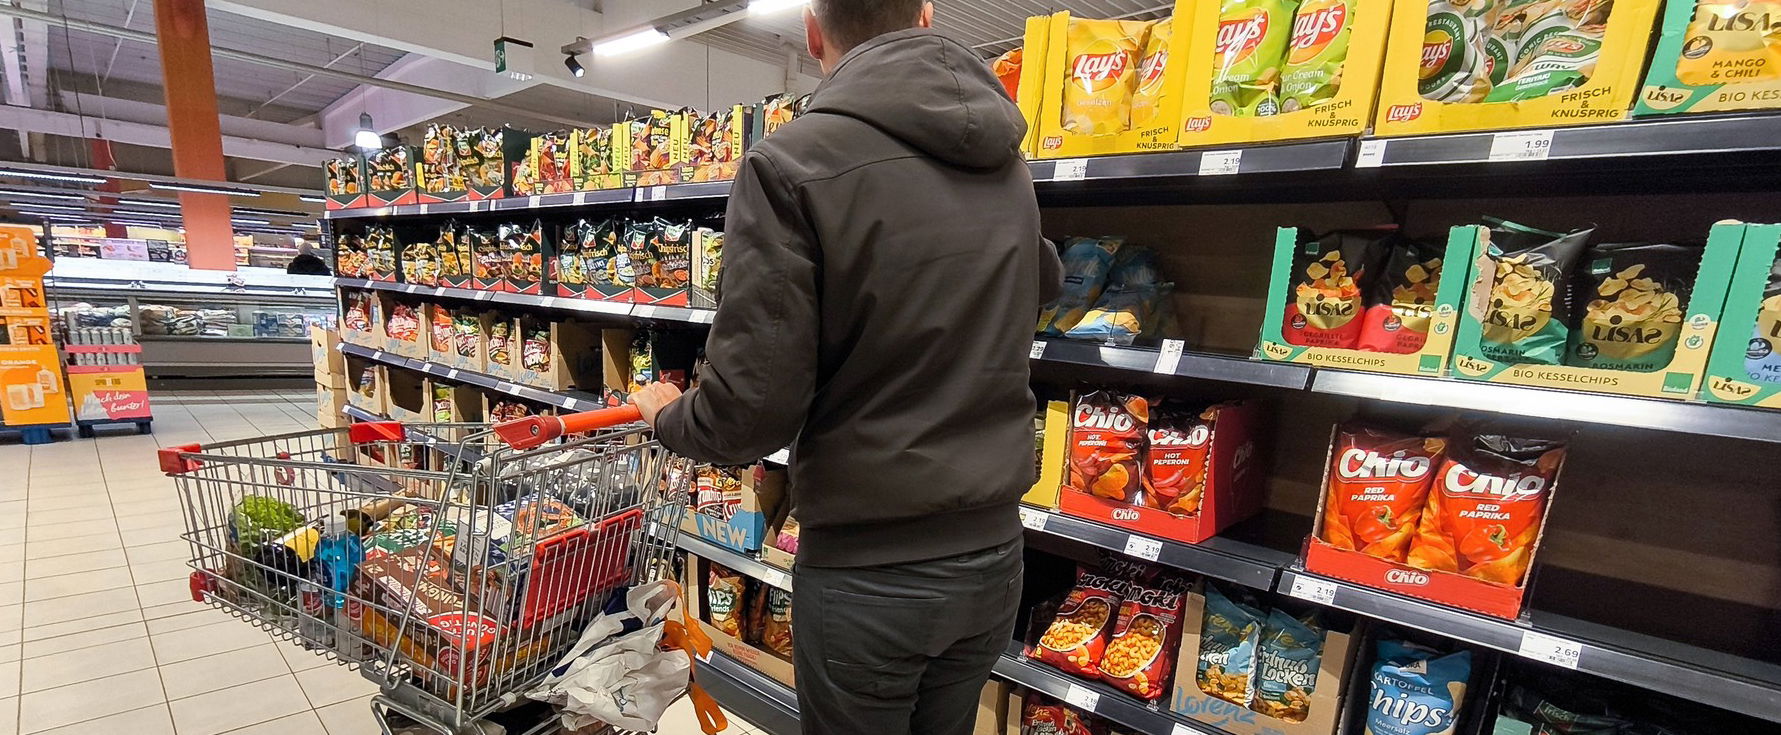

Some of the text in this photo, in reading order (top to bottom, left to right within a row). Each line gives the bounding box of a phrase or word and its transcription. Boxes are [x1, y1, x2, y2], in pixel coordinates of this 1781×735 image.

[1216, 14, 1266, 52] ay's
[1290, 7, 1342, 48] ay's
[1073, 50, 1127, 80] Lay's
[1712, 59, 1766, 68] MANGO
[1710, 69, 1761, 79] & CHILI
[1560, 86, 1612, 103] FRISCH
[1718, 90, 1781, 103] BIO KES
[1315, 100, 1352, 114] FRISCH
[1581, 101, 1589, 109] &
[1387, 103, 1422, 122] Lay's
[1551, 109, 1619, 118] KNUSPRIG
[1185, 116, 1212, 132] Lay's
[1308, 119, 1359, 127] KNUSPRIG
[1141, 126, 1169, 138] FRISCH
[1043, 136, 1062, 150] Lay's
[1136, 142, 1175, 150] KNUSPRIG
[1525, 139, 1550, 149] 1.99
[1481, 345, 1525, 355] OSMARIN
[1307, 353, 1386, 367] BIO KESSELCHIPS
[1762, 364, 1781, 373] ME
[1513, 369, 1619, 387] BIO KESSELCHIPS
[1074, 403, 1134, 431] Chio
[1153, 458, 1190, 466] PEPERONI
[1338, 448, 1431, 480] Chio
[1445, 463, 1545, 499] Chio
[1363, 486, 1385, 495] RED
[1351, 494, 1395, 502] PAPRIKA
[1475, 503, 1500, 512] RED
[1112, 508, 1140, 521] Chio
[1459, 510, 1511, 521] PAPRIKA
[702, 515, 747, 549] NEW
[1386, 569, 1429, 585] Chio
[1555, 646, 1579, 658] 2.69
[1371, 680, 1447, 727] hips
